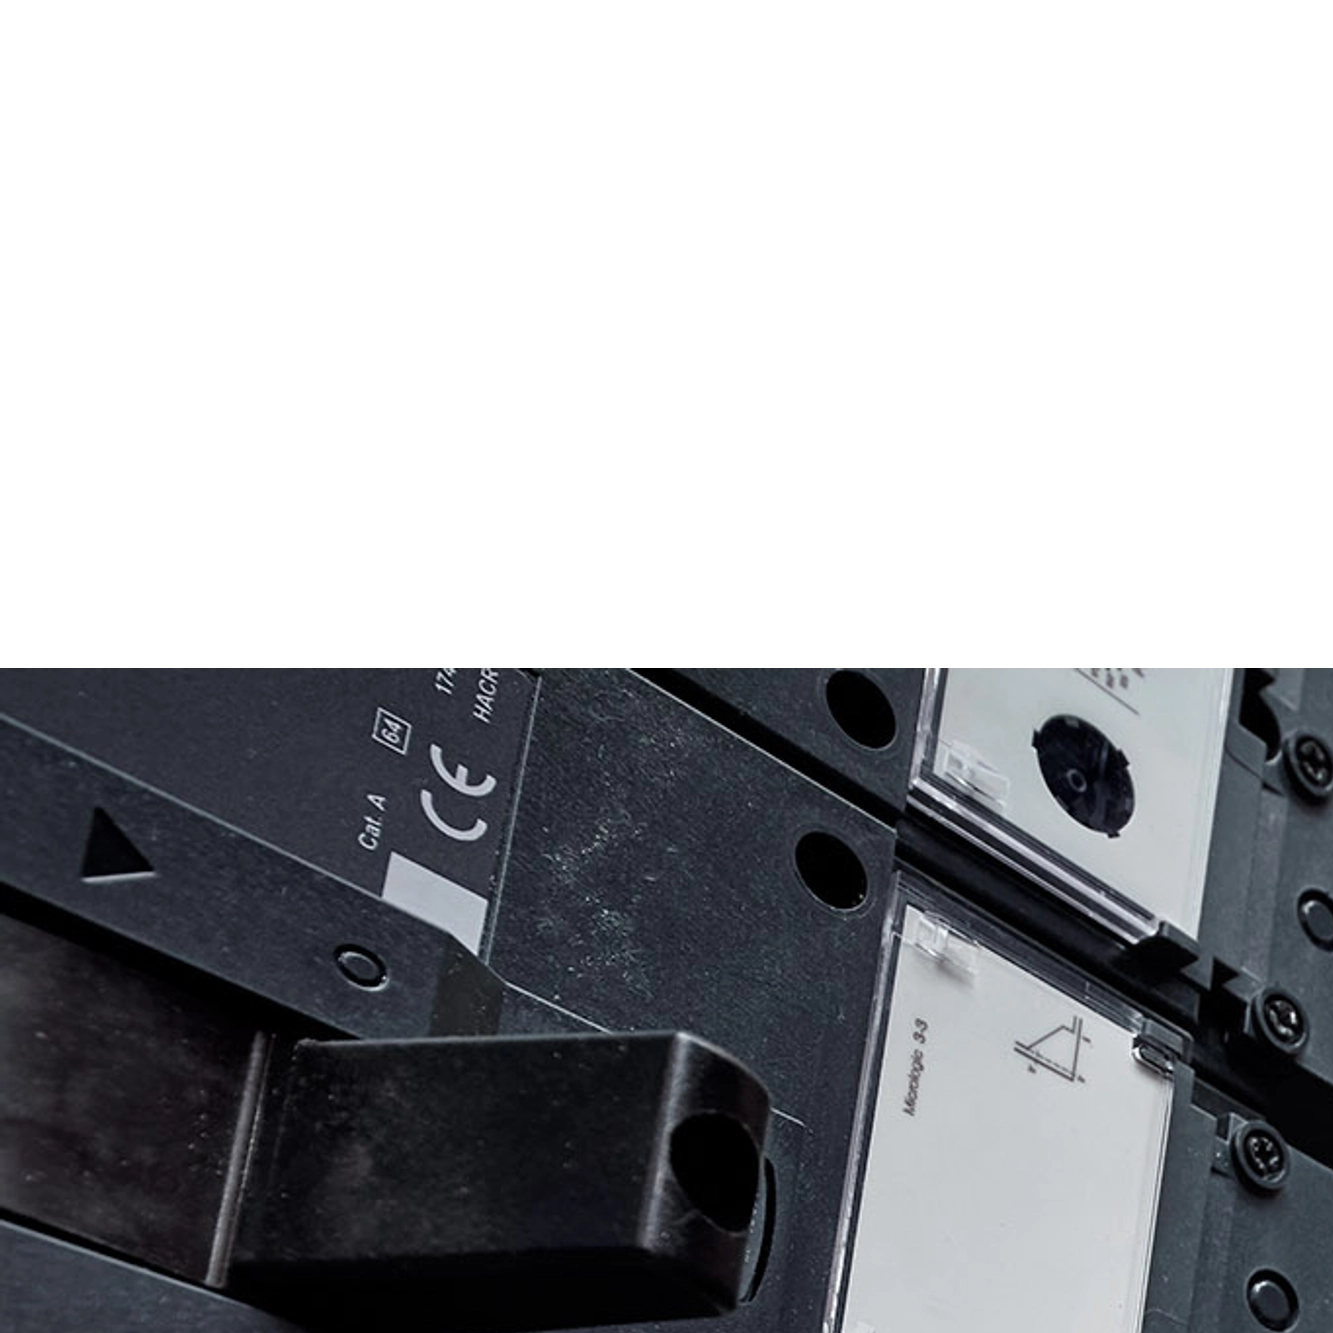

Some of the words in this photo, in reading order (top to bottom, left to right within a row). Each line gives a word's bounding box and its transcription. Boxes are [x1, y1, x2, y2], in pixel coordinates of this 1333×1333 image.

[380, 717, 403, 745] 64
[366, 792, 387, 813] A
[357, 814, 383, 851] Cat.
